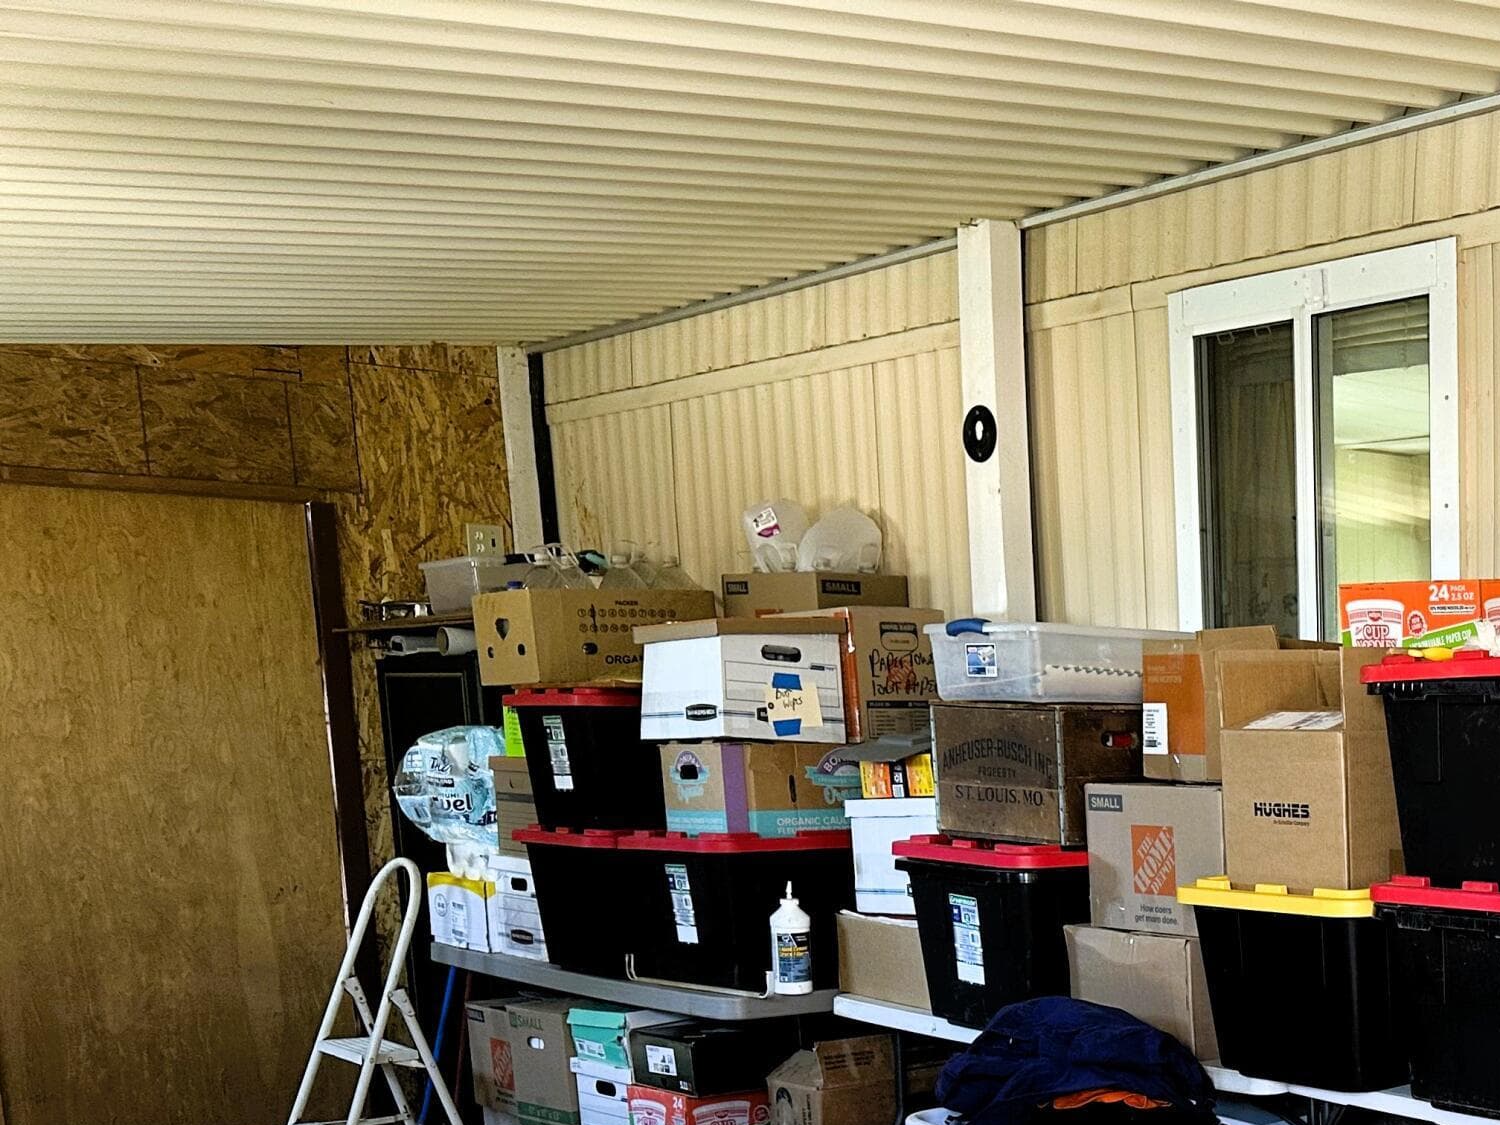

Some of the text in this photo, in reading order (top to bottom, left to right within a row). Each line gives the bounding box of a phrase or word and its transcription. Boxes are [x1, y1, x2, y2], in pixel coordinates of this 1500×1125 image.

[825, 582, 858, 592] SMALL
[1428, 584, 1449, 601] 24
[1363, 624, 1389, 639] CUP
[943, 738, 1032, 772] ANHEUSER-BUSCH
[1091, 797, 1120, 809] SMALL
[1254, 802, 1310, 818] HUGHES
[777, 817, 821, 827] ORGANIC
[1136, 833, 1154, 859] THE
[1135, 826, 1175, 893] HOME
[1150, 853, 1175, 894] DEPOT
[1141, 904, 1154, 912] How
[1135, 914, 1145, 923] get
[518, 1015, 543, 1030] SMALL
[673, 1096, 683, 1110] 24
